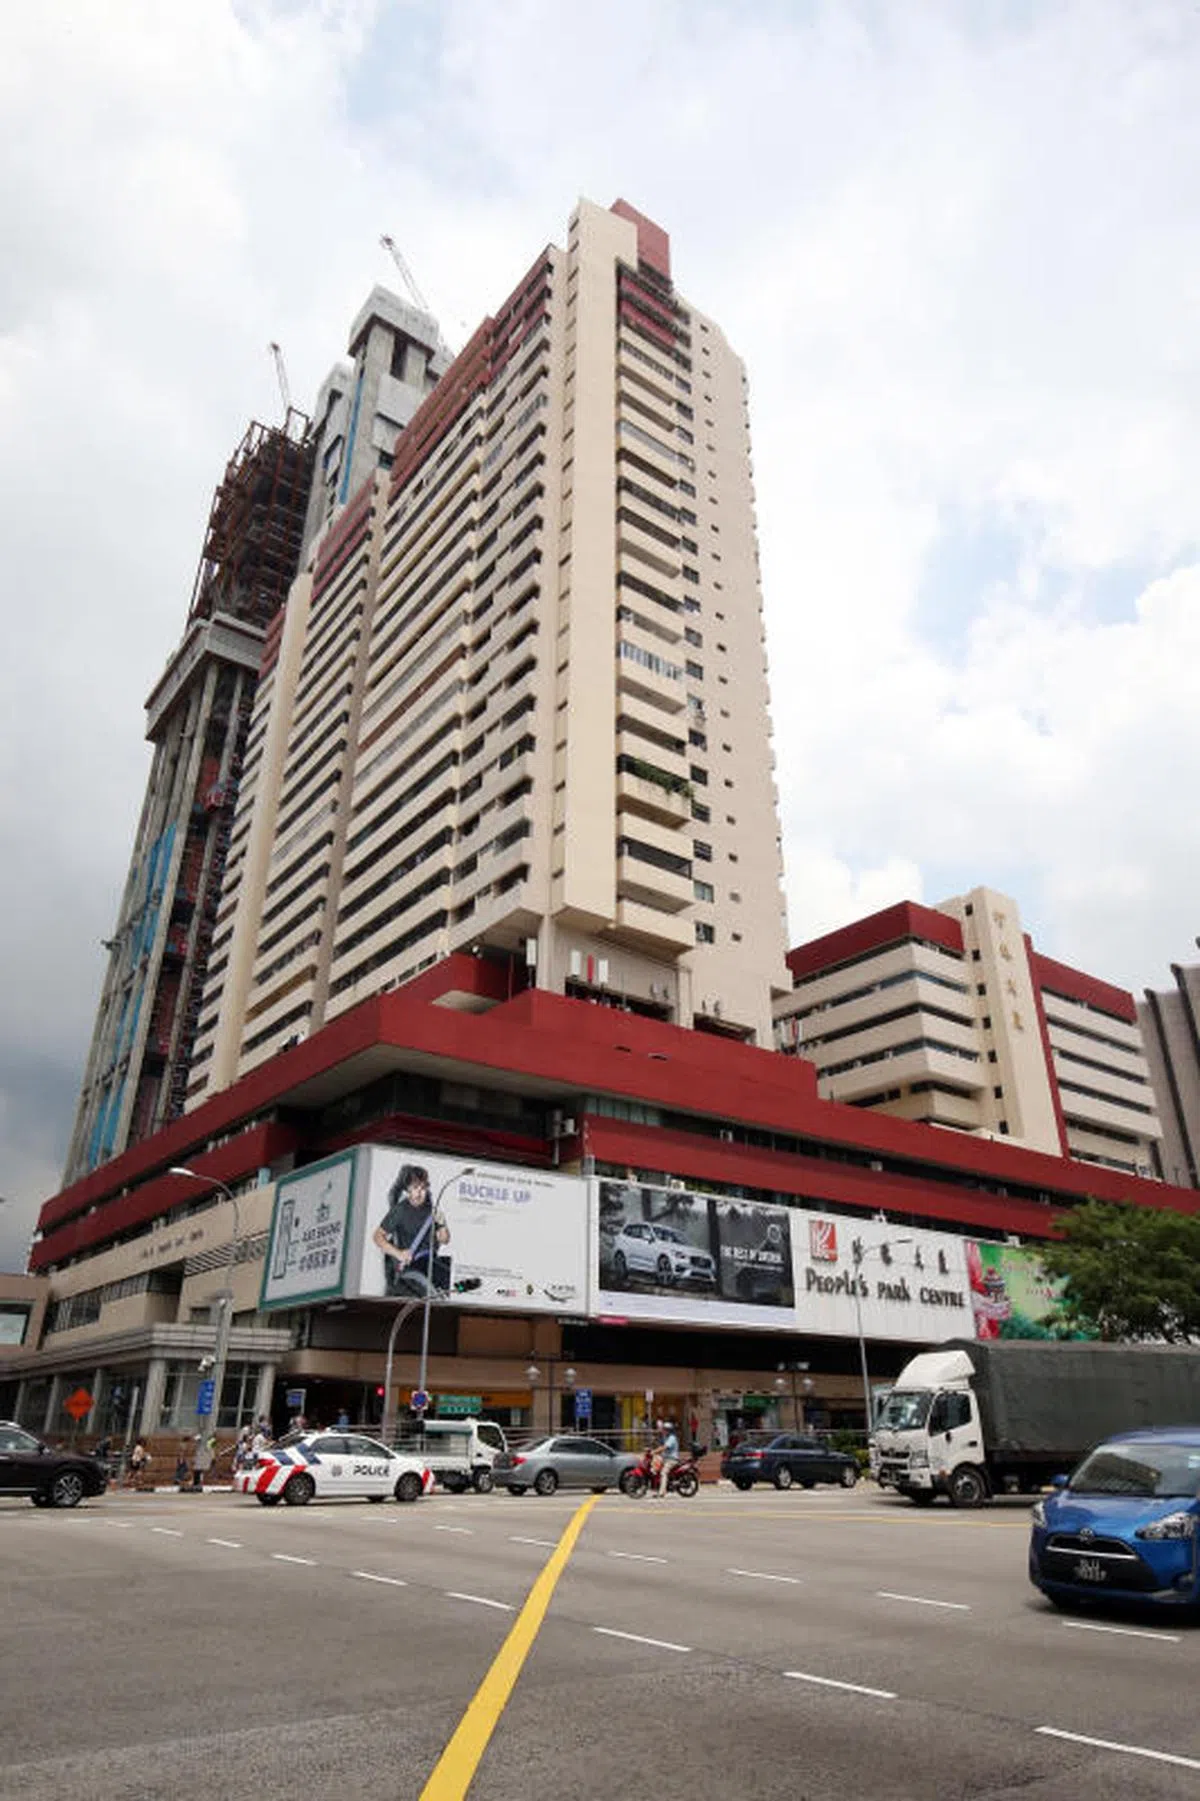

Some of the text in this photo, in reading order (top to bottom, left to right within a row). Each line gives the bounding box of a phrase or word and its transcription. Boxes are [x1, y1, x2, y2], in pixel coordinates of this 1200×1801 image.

[459, 1182, 510, 1201] BUCKLE
[513, 1190, 532, 1203] UP
[354, 1465, 390, 1478] POLICE
